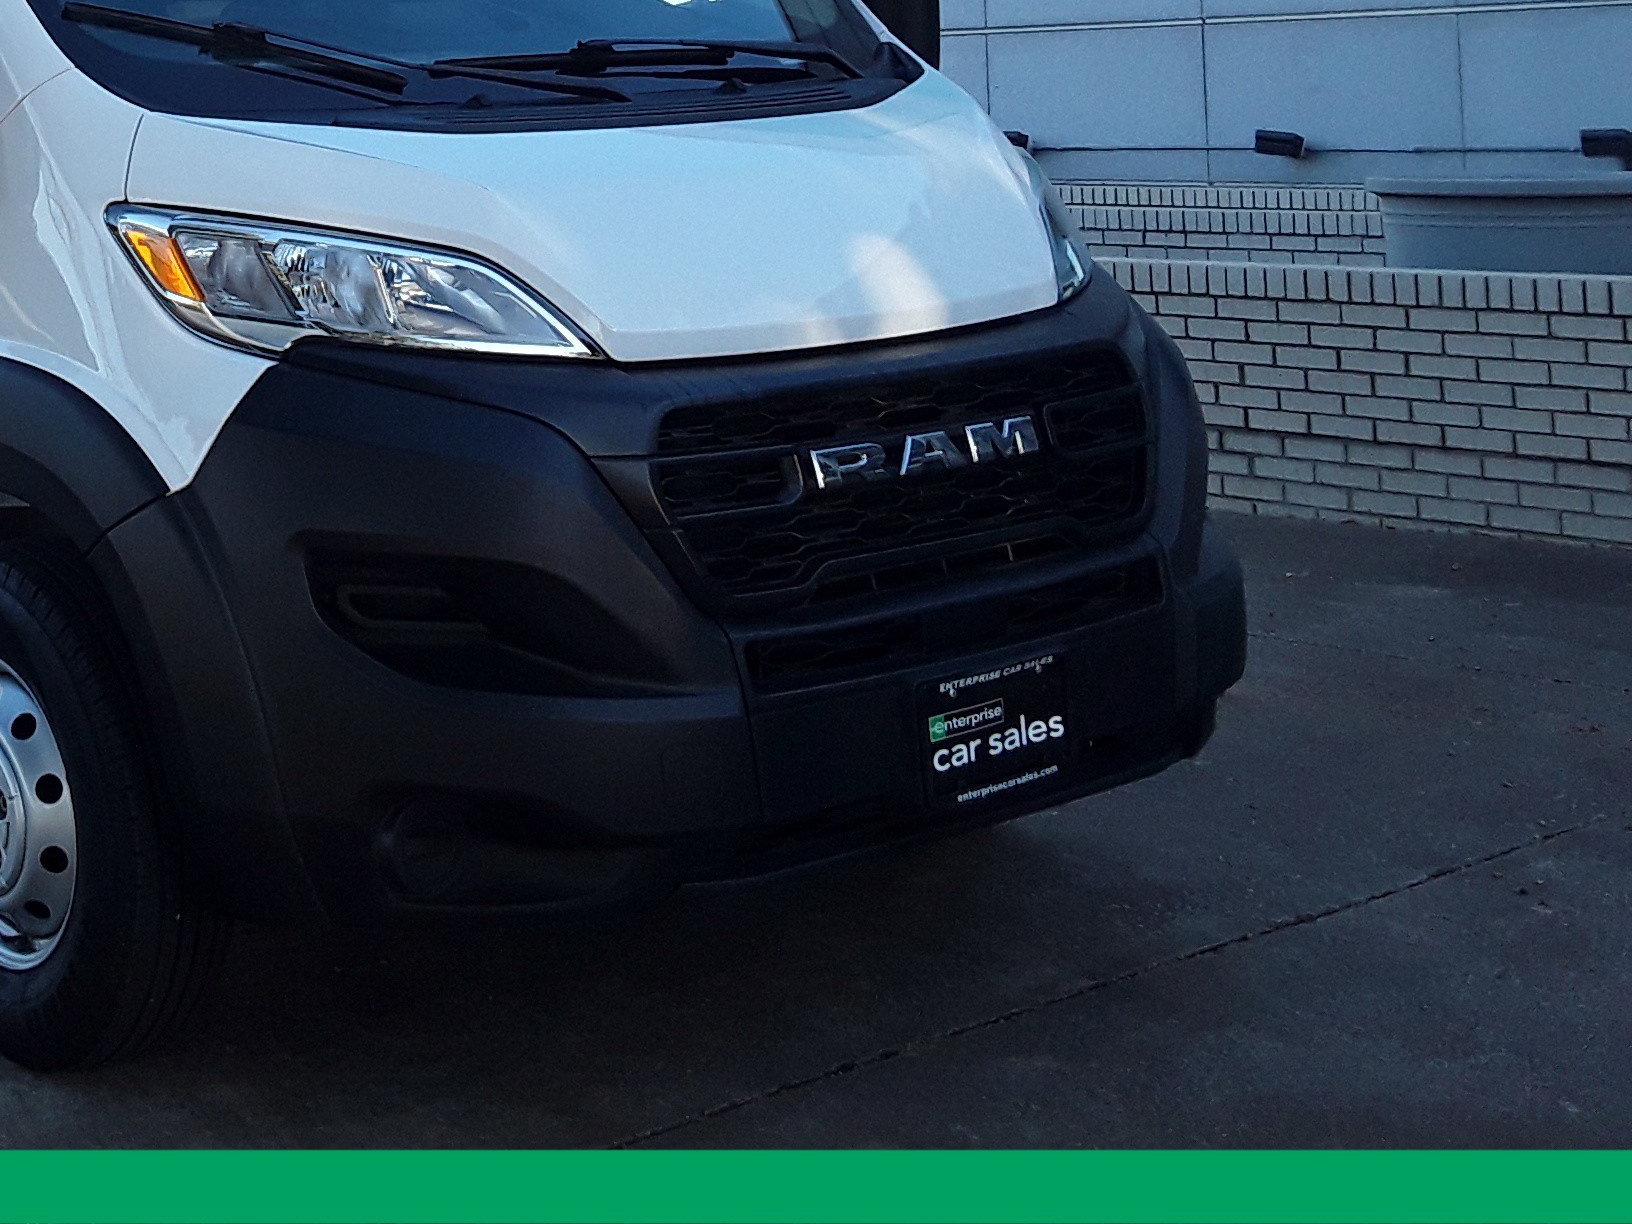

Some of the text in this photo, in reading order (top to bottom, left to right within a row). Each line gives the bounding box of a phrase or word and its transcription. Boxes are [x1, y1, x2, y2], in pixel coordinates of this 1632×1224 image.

[810, 415, 1040, 490] RAM
[933, 706, 1002, 734] enterprise
[933, 713, 1065, 772] car sales
